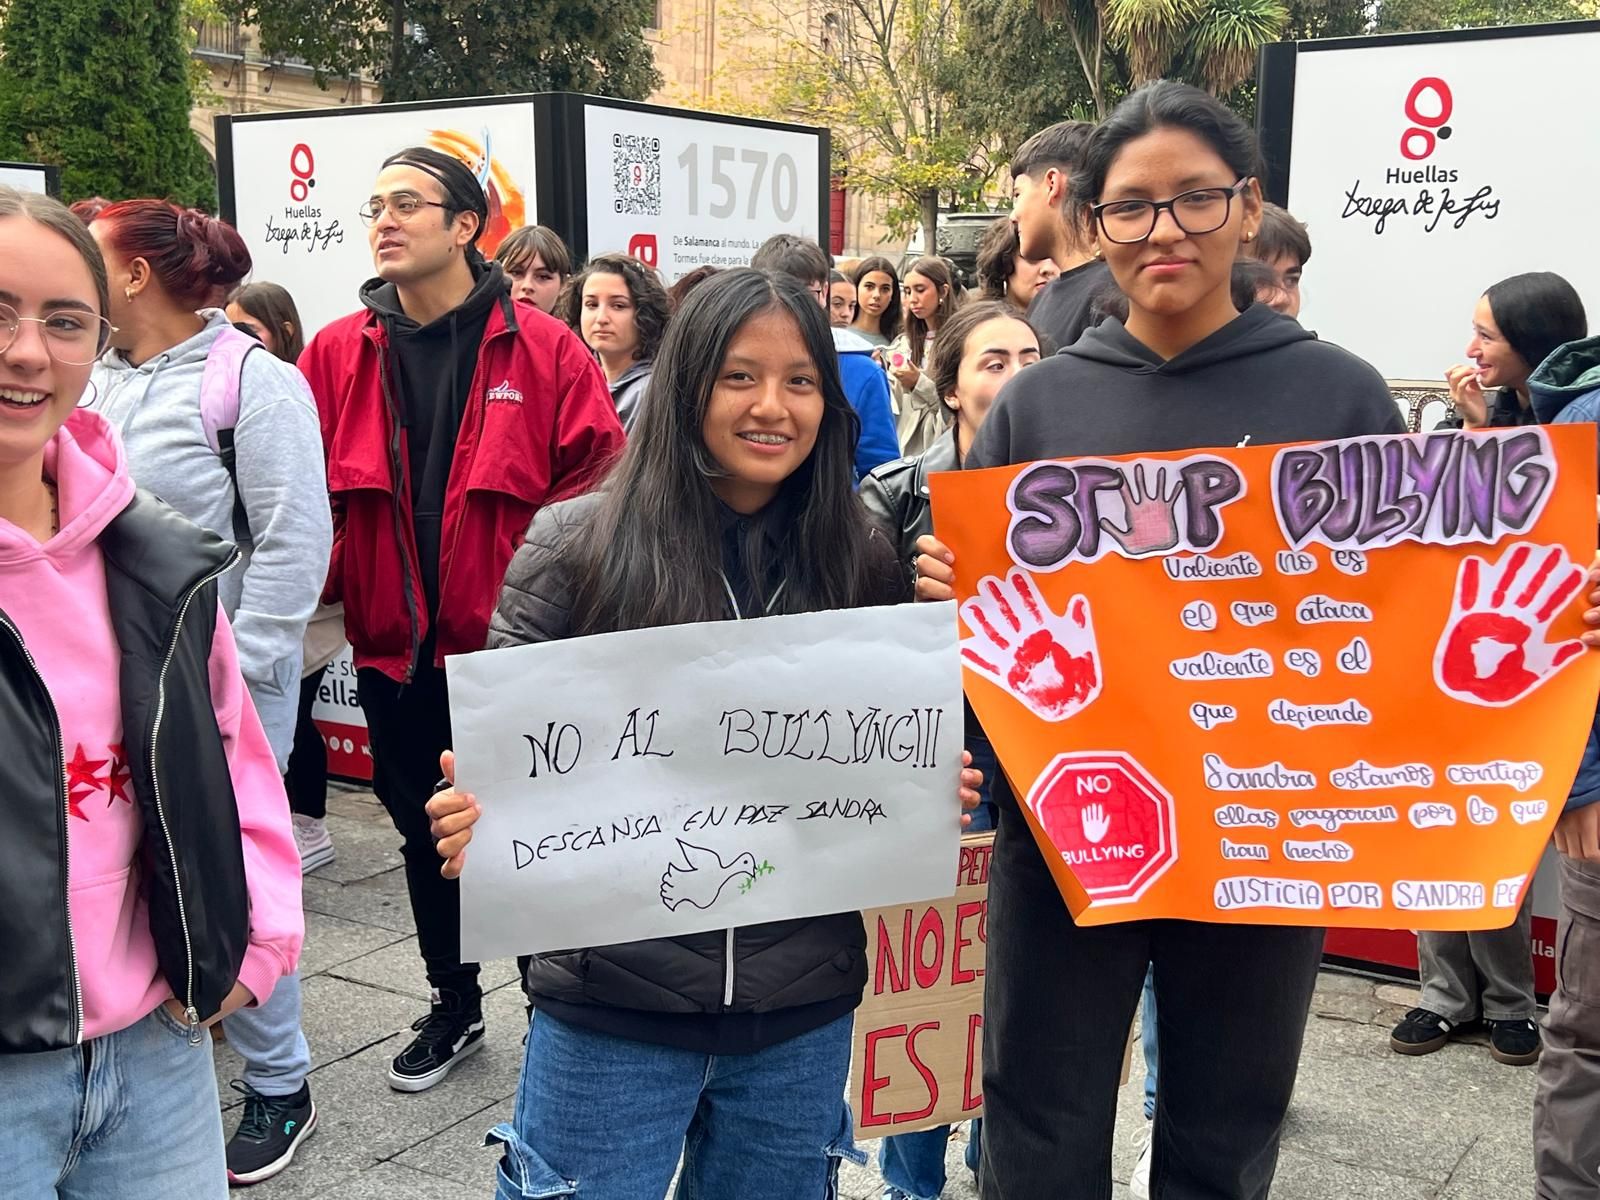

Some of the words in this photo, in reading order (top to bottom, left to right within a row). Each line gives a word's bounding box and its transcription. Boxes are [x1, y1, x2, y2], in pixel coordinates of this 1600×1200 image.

[677, 142, 798, 222] 1570
[1386, 165, 1458, 184] Huellas
[285, 205, 321, 218] Huellas
[673, 235, 683, 246] De
[684, 236, 720, 247] Salamanca
[721, 238, 727, 248] al
[673, 253, 698, 264] Tormes
[699, 253, 710, 264] fue
[711, 254, 727, 265] clave
[728, 257, 742, 266] para
[1279, 432, 1550, 545] BULLYING
[1279, 552, 1313, 573] no
[1335, 550, 1366, 573] es
[1183, 603, 1213, 628] el
[1234, 602, 1275, 624] que
[1300, 596, 1369, 622] ataca
[1172, 652, 1269, 677] valiente
[1289, 651, 1319, 676] es
[1340, 640, 1368, 670] el
[1193, 703, 1234, 729] que
[1271, 700, 1369, 728] defiende
[523, 721, 582, 778] NO
[611, 707, 675, 760] AL
[1076, 774, 1112, 796] NO
[1205, 754, 1316, 789] Sandra
[1332, 762, 1433, 787] estamos
[1447, 761, 1540, 789] contigo
[1217, 805, 1277, 826] ellas
[1290, 805, 1397, 830] pagaran
[1413, 804, 1454, 825] por
[1470, 797, 1496, 824] lo
[1513, 800, 1546, 822] que
[513, 815, 661, 869] DESCANSA
[683, 805, 728, 832] EN
[734, 804, 789, 825] PAZ
[797, 798, 887, 825] SANDRA
[1061, 843, 1145, 866] BULLYING
[1221, 840, 1267, 859] han
[1285, 841, 1350, 860] hecho
[1331, 883, 1380, 907] POR
[1396, 883, 1484, 907] SANDRA
[874, 906, 944, 996] NO
[860, 1020, 940, 1128] ES
